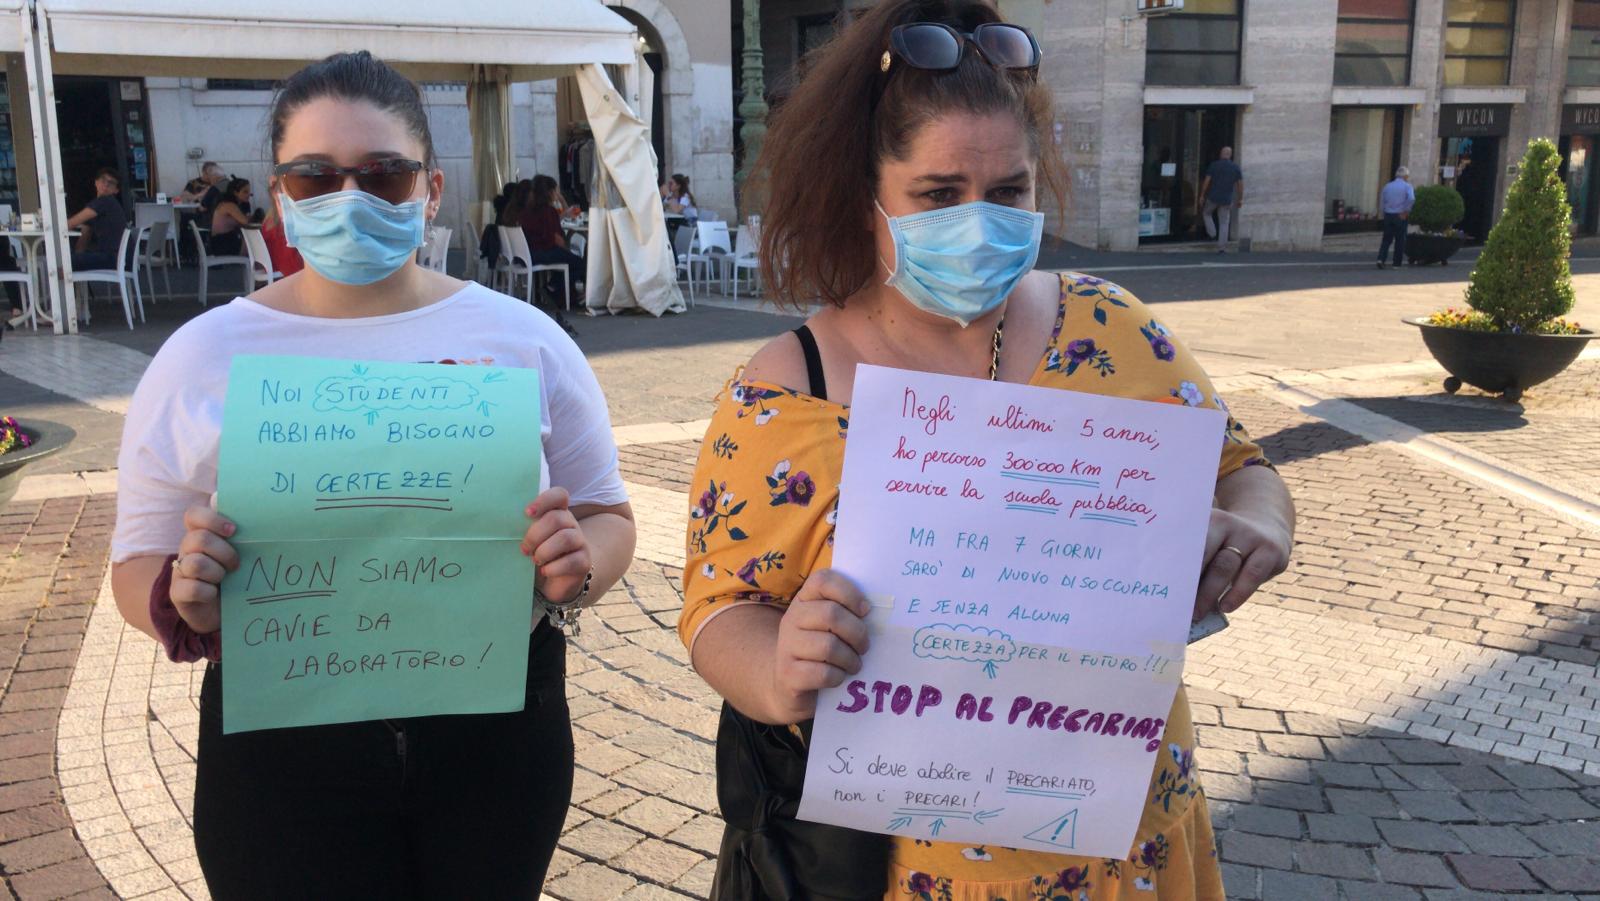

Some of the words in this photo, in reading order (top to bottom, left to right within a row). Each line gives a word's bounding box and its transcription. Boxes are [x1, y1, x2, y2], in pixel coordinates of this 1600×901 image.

[1456, 107, 1494, 125] WYCON
[326, 382, 448, 403] STUDENTI
[258, 421, 356, 444] ABBIAMO
[386, 422, 495, 443] BISOGNO
[902, 386, 957, 435] Negli
[987, 404, 1056, 433] ultimi
[1080, 419, 1094, 437] 5
[1103, 424, 1160, 451] anni,
[270, 471, 295, 493] DI
[315, 463, 474, 494] CERTEZZE!
[892, 435, 917, 461] ho
[921, 449, 987, 473] percorso
[1116, 467, 1156, 489] per
[885, 477, 949, 497] servire
[960, 478, 984, 500] la
[1004, 488, 1063, 507] scuola
[1068, 492, 1157, 524] pubblica,
[909, 527, 936, 549] MA
[956, 532, 989, 552] FRA
[1015, 536, 1027, 553] 7
[1040, 539, 1103, 561] GIORNI
[246, 555, 337, 592] NON
[359, 556, 462, 585] SIAMO
[961, 565, 976, 580] DI
[998, 566, 1049, 585] NUOVO
[1061, 574, 1170, 599] DISOCCUPATA
[244, 613, 331, 646] CAVIE
[356, 612, 392, 632] DA
[907, 598, 922, 614] E
[930, 599, 990, 617] SENZA
[1007, 605, 1073, 626] ALCUNA
[283, 642, 493, 680] LABORATORIO!
[921, 634, 1006, 656] CERTEZZA
[1017, 645, 1049, 661] PER
[1057, 650, 1072, 664] IL
[836, 680, 943, 717] STOP
[955, 692, 994, 723] AL
[828, 747, 854, 776] Si
[867, 754, 907, 778] deve
[917, 761, 972, 784] abolire
[985, 768, 994, 785] il
[1007, 769, 1097, 797] PRECARIATO,
[833, 789, 866, 803] non
[876, 789, 886, 803] i
